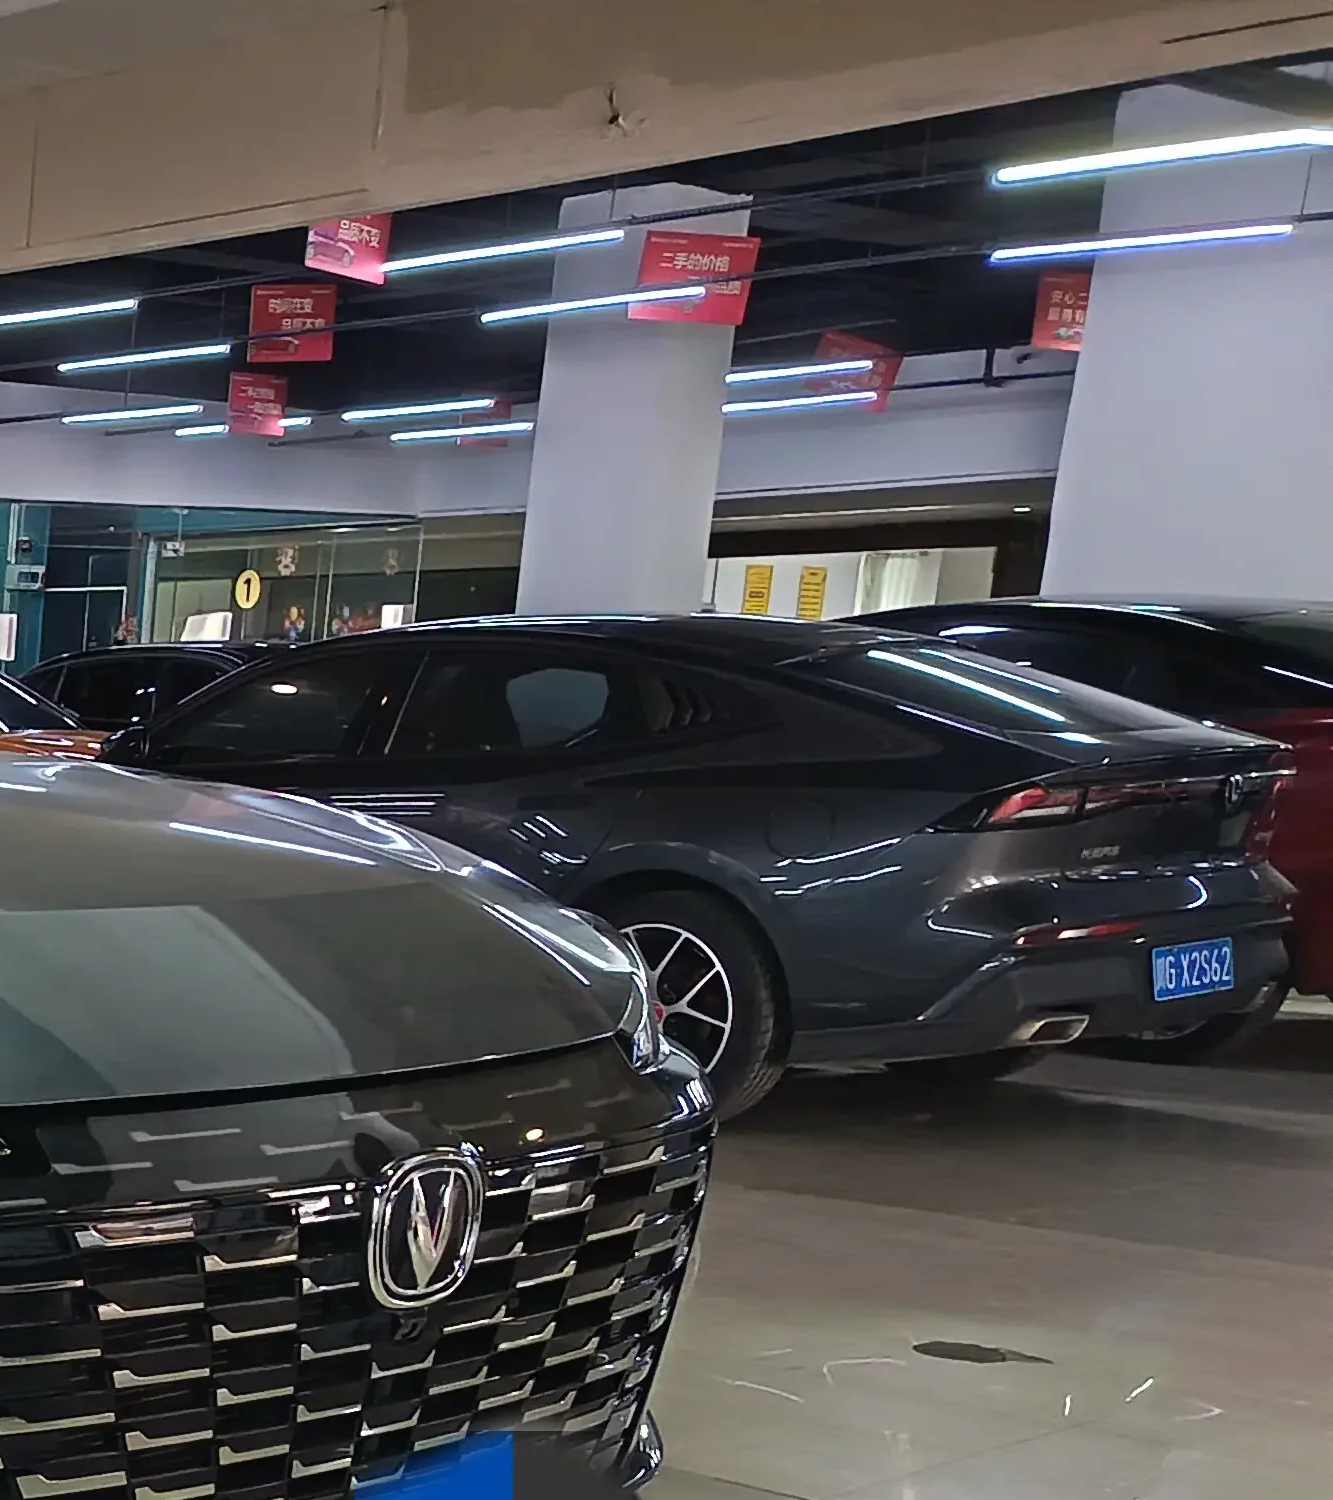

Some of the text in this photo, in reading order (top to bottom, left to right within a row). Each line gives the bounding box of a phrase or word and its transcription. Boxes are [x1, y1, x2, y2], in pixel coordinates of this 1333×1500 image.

[659, 252, 731, 272] 二手的价格
[243, 577, 252, 603] 1
